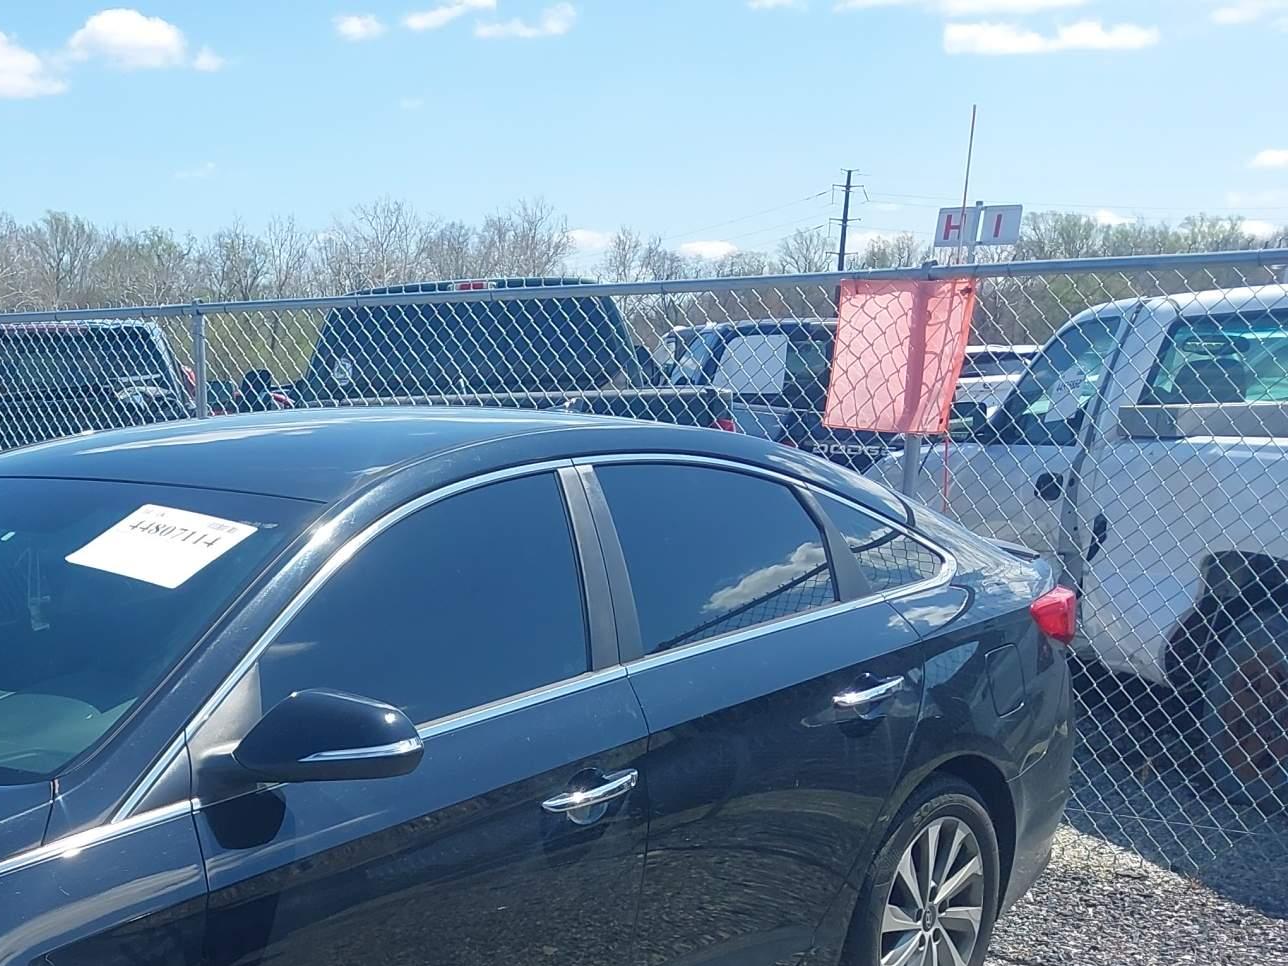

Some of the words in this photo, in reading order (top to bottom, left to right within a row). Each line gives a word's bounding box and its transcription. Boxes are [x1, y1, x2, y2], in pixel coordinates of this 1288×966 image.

[943, 213, 967, 241] H
[812, 442, 897, 457] DODGE
[129, 519, 222, 548] 44807114
